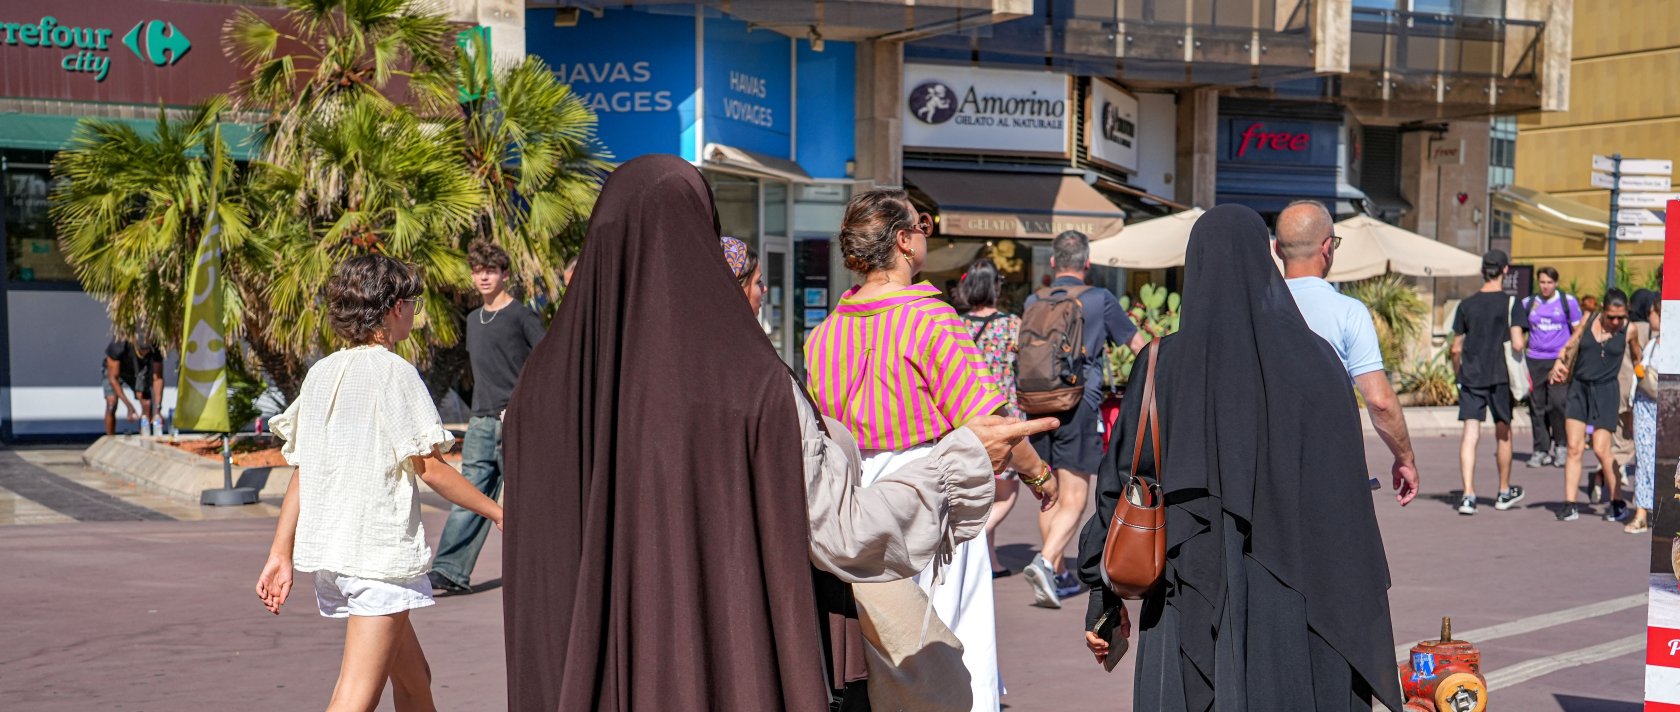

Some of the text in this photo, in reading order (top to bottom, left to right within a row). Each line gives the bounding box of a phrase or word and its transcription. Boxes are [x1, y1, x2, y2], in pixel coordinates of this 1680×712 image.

[61, 50, 111, 82] city
[546, 61, 652, 84] HAVAS
[729, 70, 767, 98] HAVAS
[723, 96, 773, 127] VOYAGES
[957, 85, 1065, 118] Amorino
[955, 115, 1063, 129] GELATO AL NATURALE
[1237, 122, 1310, 157] free
